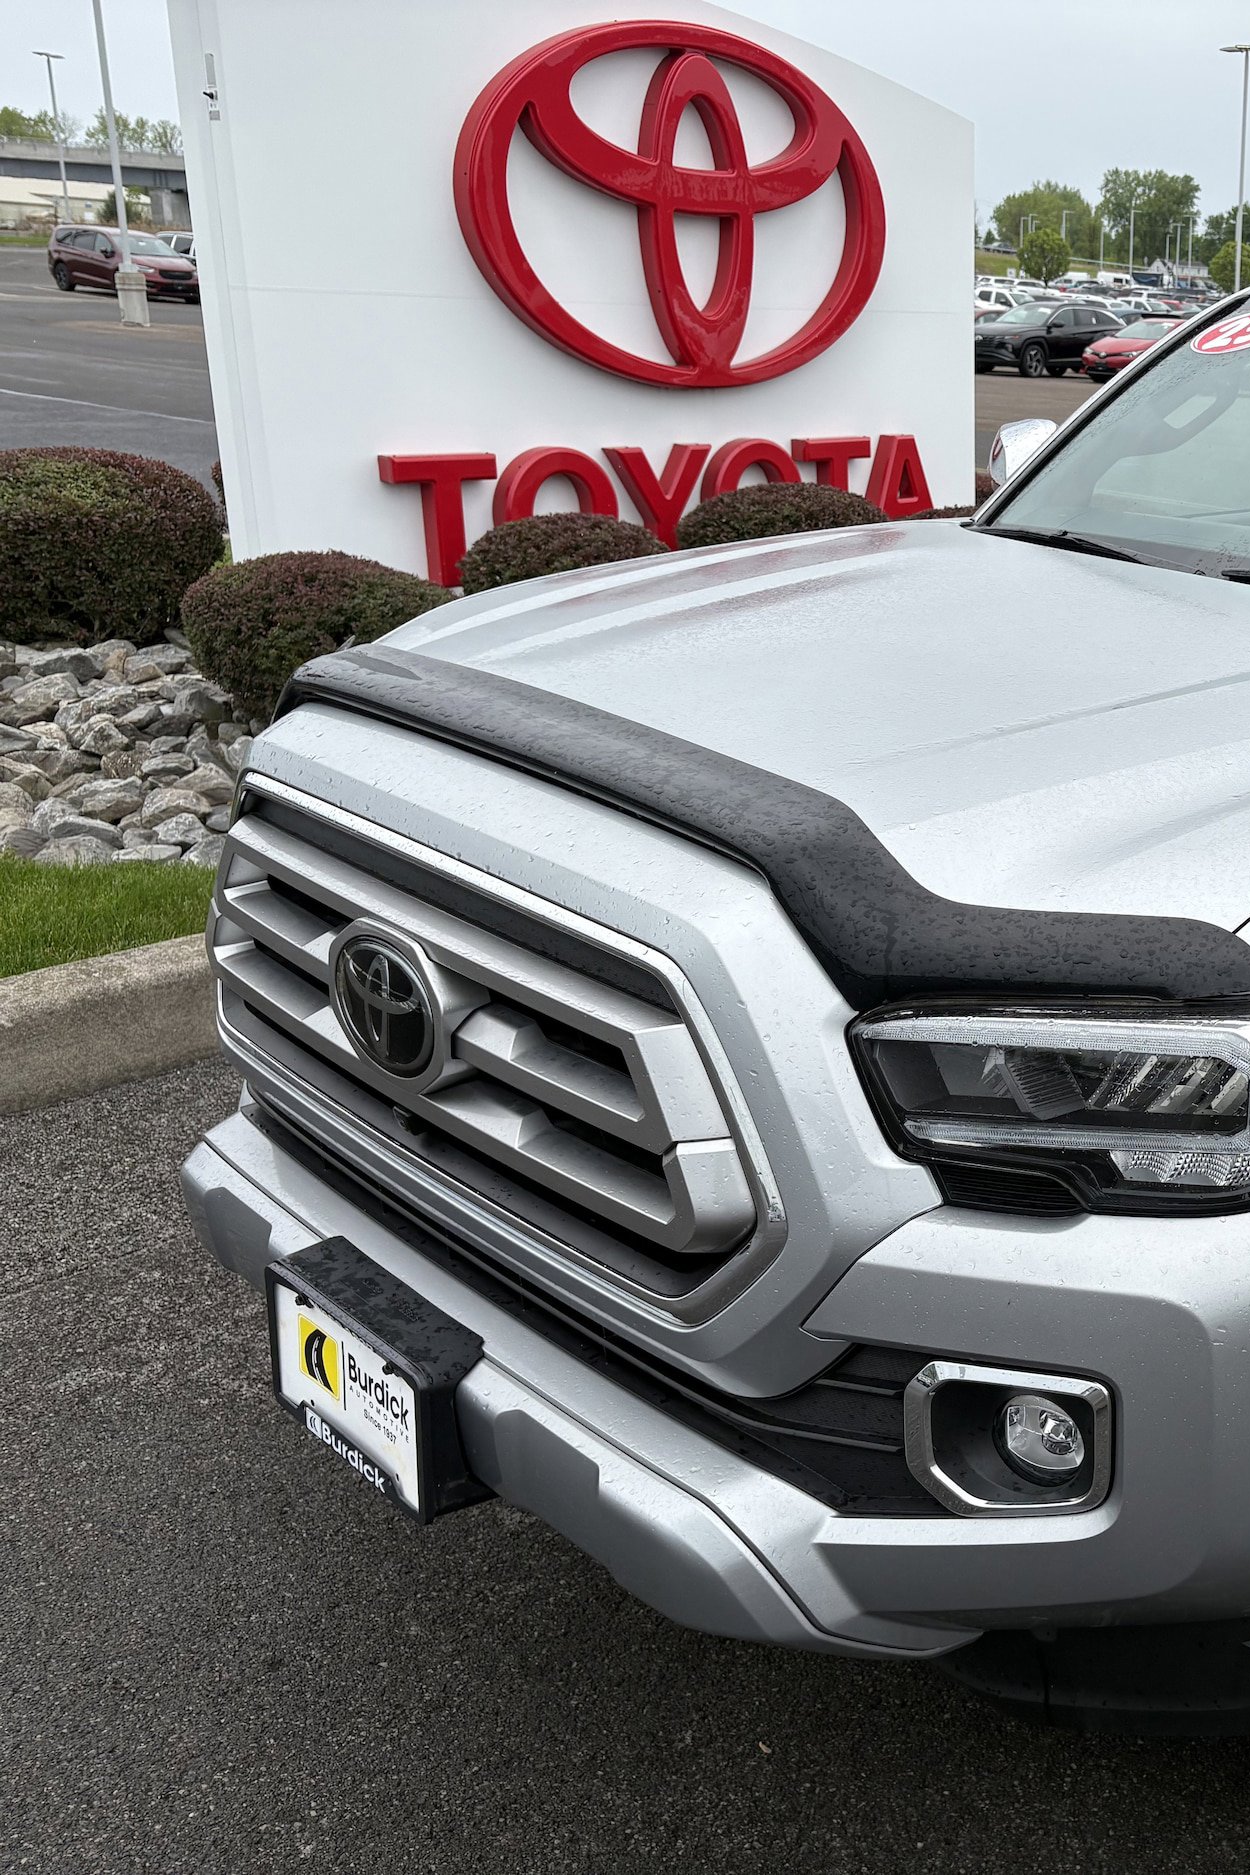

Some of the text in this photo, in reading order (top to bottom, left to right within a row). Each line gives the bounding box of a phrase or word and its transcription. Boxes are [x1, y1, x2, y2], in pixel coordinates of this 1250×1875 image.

[348, 1352, 409, 1432] Burdick
[349, 1385, 410, 1444] AUTOMOTIVE
[321, 1421, 386, 1494] Burdick
[363, 1408, 397, 1445] Since 1937
